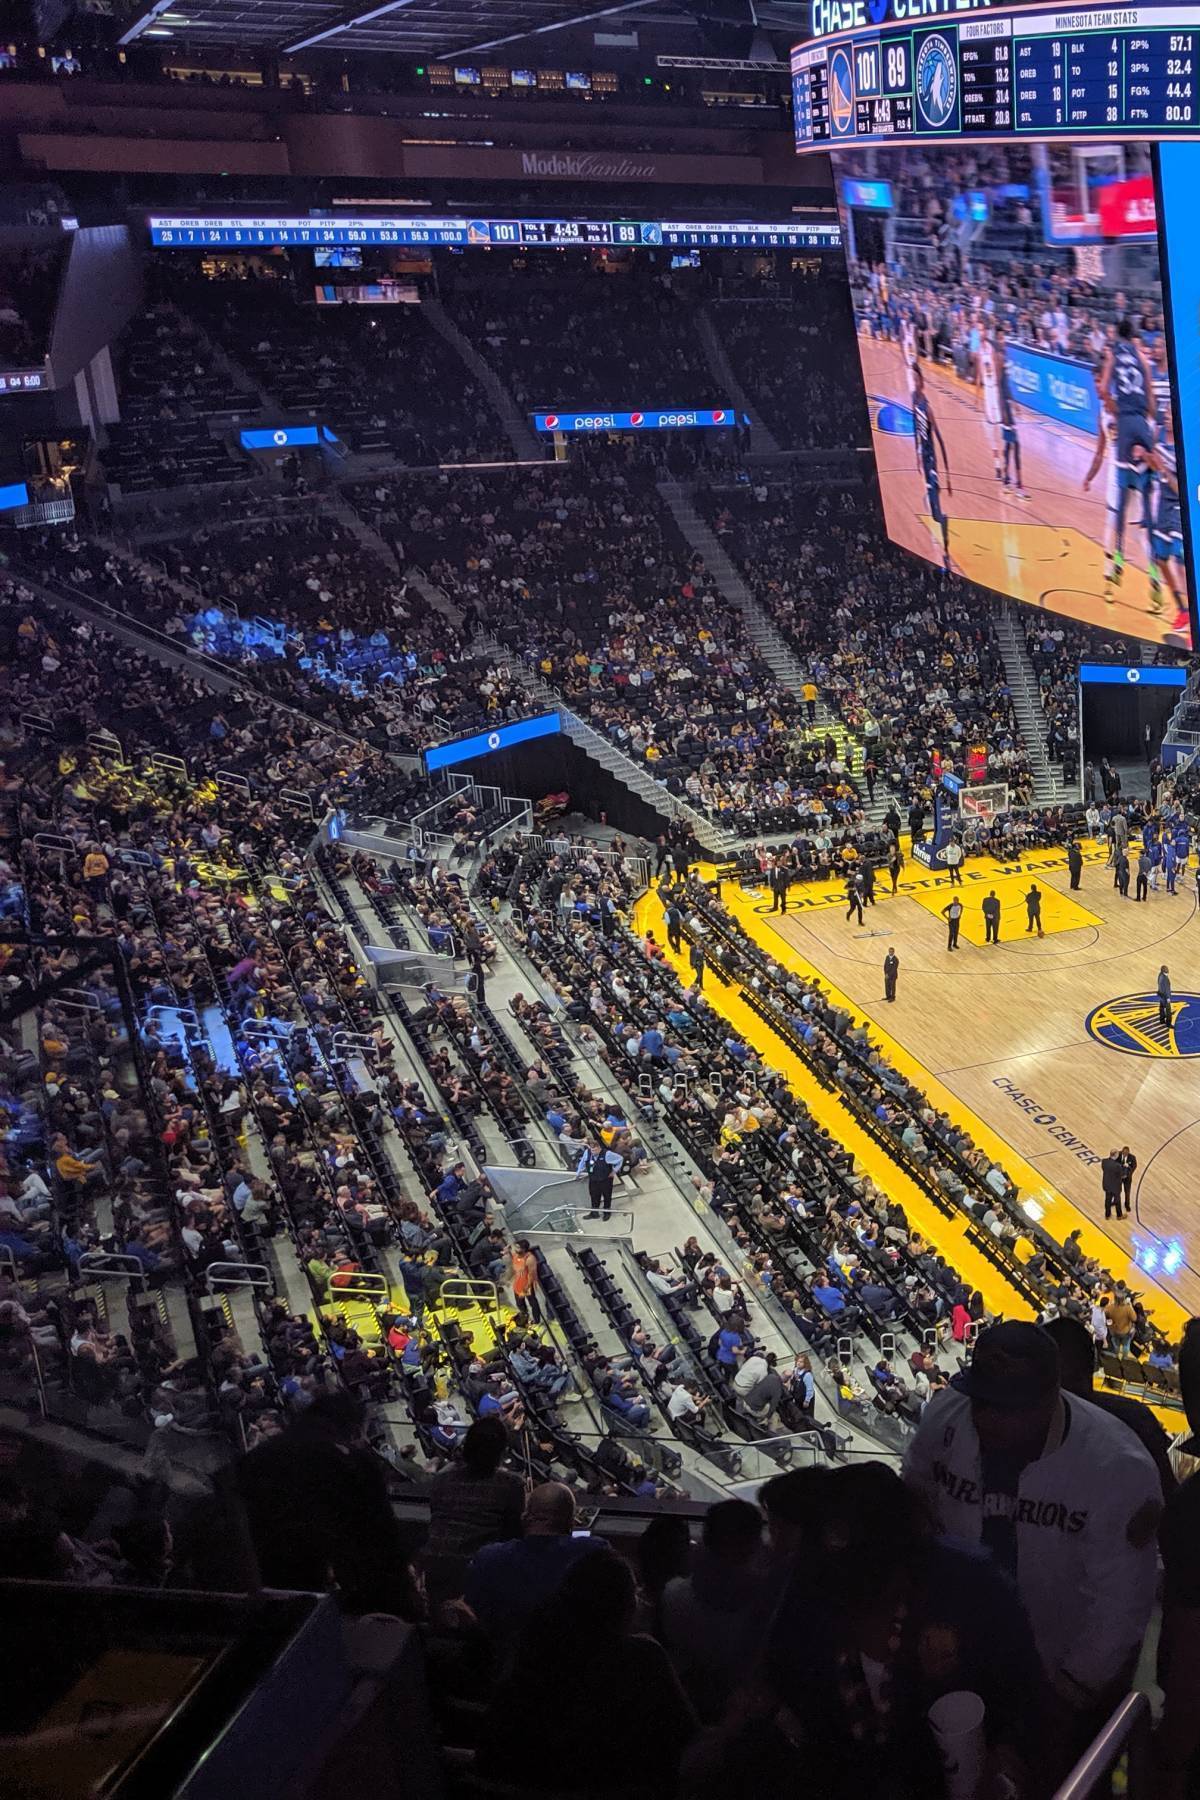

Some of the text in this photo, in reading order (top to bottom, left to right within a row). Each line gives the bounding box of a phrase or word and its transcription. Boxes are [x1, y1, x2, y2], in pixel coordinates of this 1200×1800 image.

[1056, 12, 1138, 29] MINNESOTA TEAM STATS
[966, 22, 1004, 37] FOUR FACTORS
[1020, 42, 1060, 56] AST 19
[1072, 38, 1118, 53] BLK 4
[1131, 36, 1192, 51] 2P% 57.1
[858, 51, 876, 90] 101
[888, 47, 906, 87] 89
[1020, 65, 1060, 79] OREB 11
[1072, 62, 1118, 76] TO 12
[1131, 60, 1192, 74] 3P% 32.4
[996, 68, 1009, 82] 13.2
[1020, 86, 1061, 101] DREB 18
[1072, 84, 1118, 98] POT 15
[1131, 83, 1192, 98] FG% 44.4
[874, 100, 890, 122] 4:43
[906, 98, 910, 110] 4
[1021, 109, 1062, 122] STL 5
[1072, 106, 1118, 121] PITP 38
[1131, 106, 1191, 120] FT% 80.0
[907, 118, 911, 129] 4
[522, 153, 656, 177] Modelo Cantina
[494, 225, 515, 240] 101
[540, 224, 545, 232] 4
[555, 224, 578, 236] 4:43
[620, 226, 634, 240] 89
[188, 231, 194, 240] 7
[210, 231, 220, 240] 24
[280, 231, 288, 240] 14
[302, 231, 310, 240] 17
[324, 231, 334, 240] 34
[380, 231, 398, 240] 53.8
[440, 231, 462, 240] 100.0
[670, 234, 678, 243] 19
[751, 234, 756, 243] 4
[770, 235, 778, 244] 12
[789, 235, 796, 244] 15
[24, 375, 40, 386] 6:00
[575, 415, 614, 429] pepsi
[659, 412, 698, 426] pepsi
[753, 870, 982, 914] GOLDN STAE
[992, 1076, 1101, 1167] CHASE CENTER
